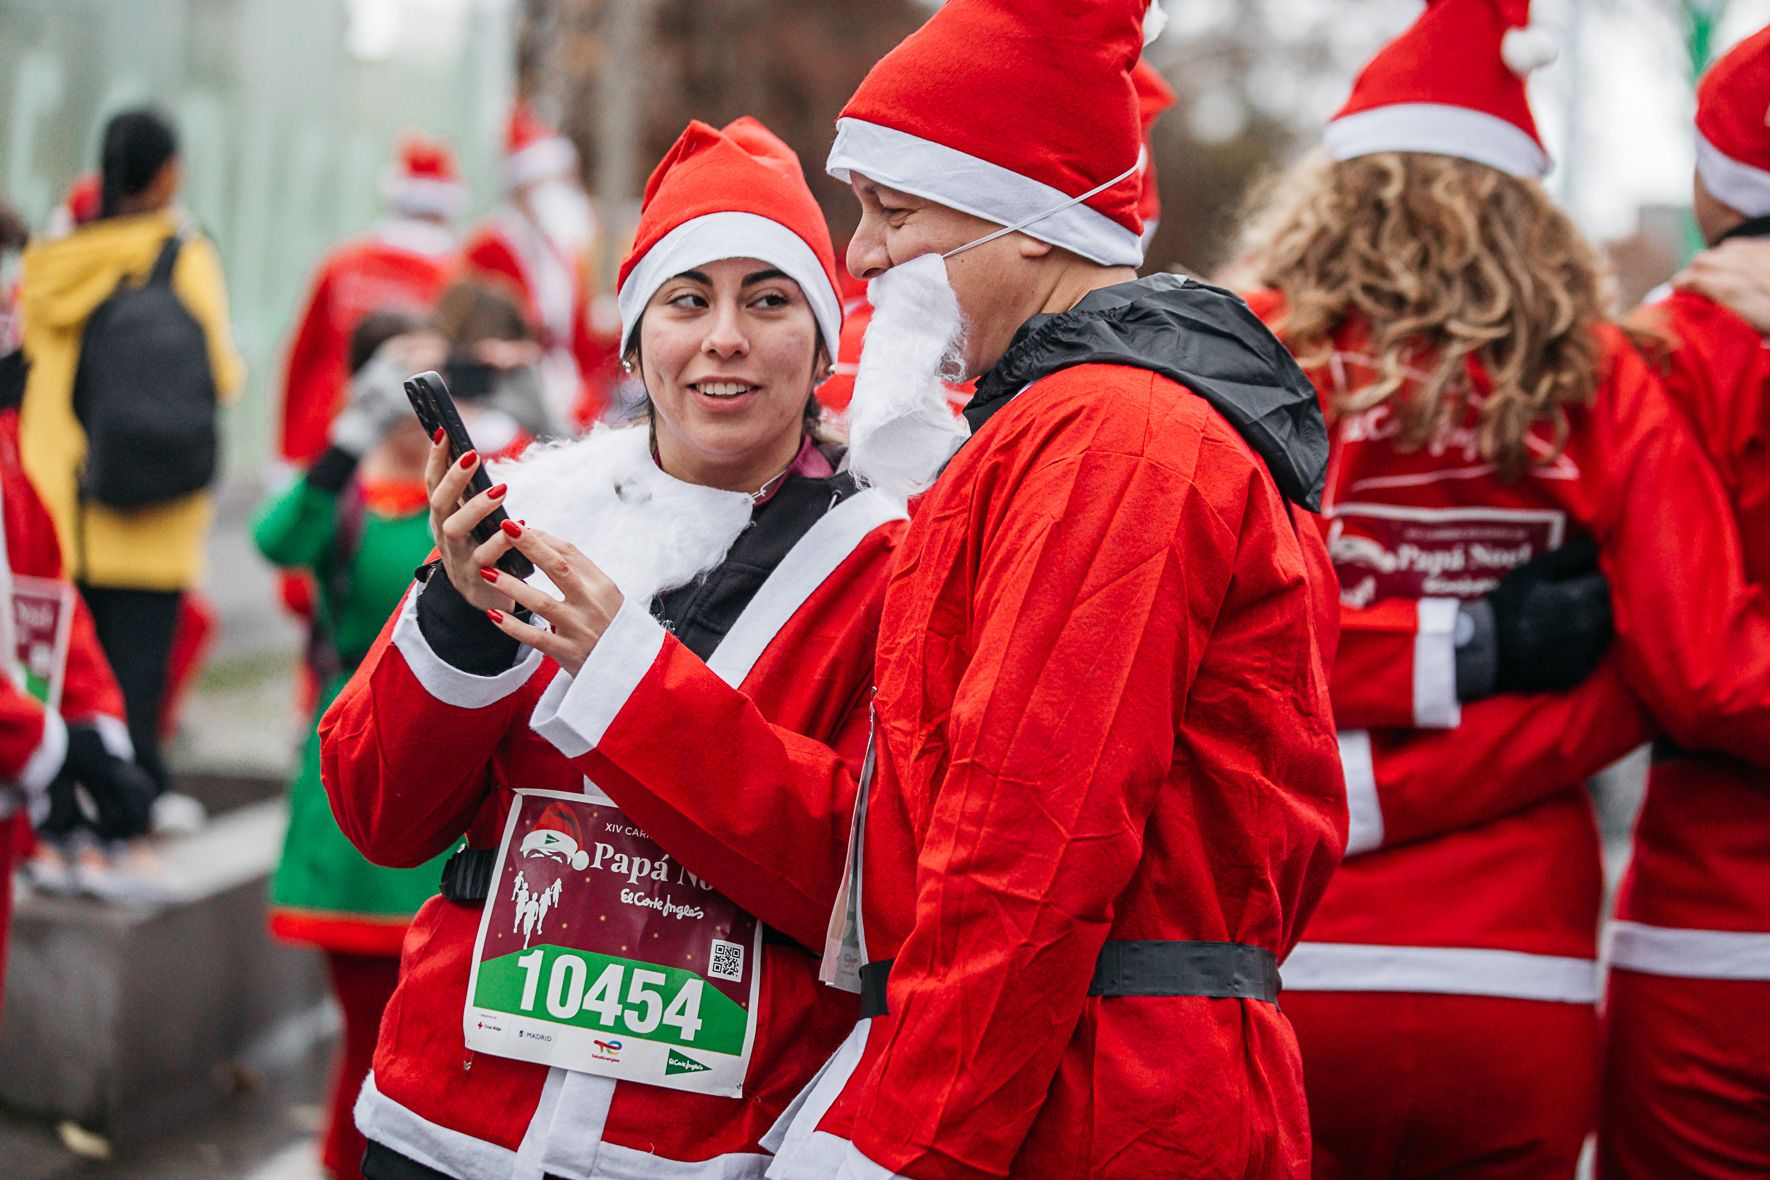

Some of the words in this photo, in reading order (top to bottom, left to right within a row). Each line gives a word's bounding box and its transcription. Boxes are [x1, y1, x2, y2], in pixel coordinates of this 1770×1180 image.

[605, 822, 623, 833] XIV
[625, 826, 653, 839] CAR
[590, 841, 670, 884] Papá
[676, 866, 714, 891] No
[620, 888, 634, 904] El
[634, 892, 663, 911] Corte
[518, 949, 704, 1041] 10454
[526, 1031, 552, 1042] MADRID
